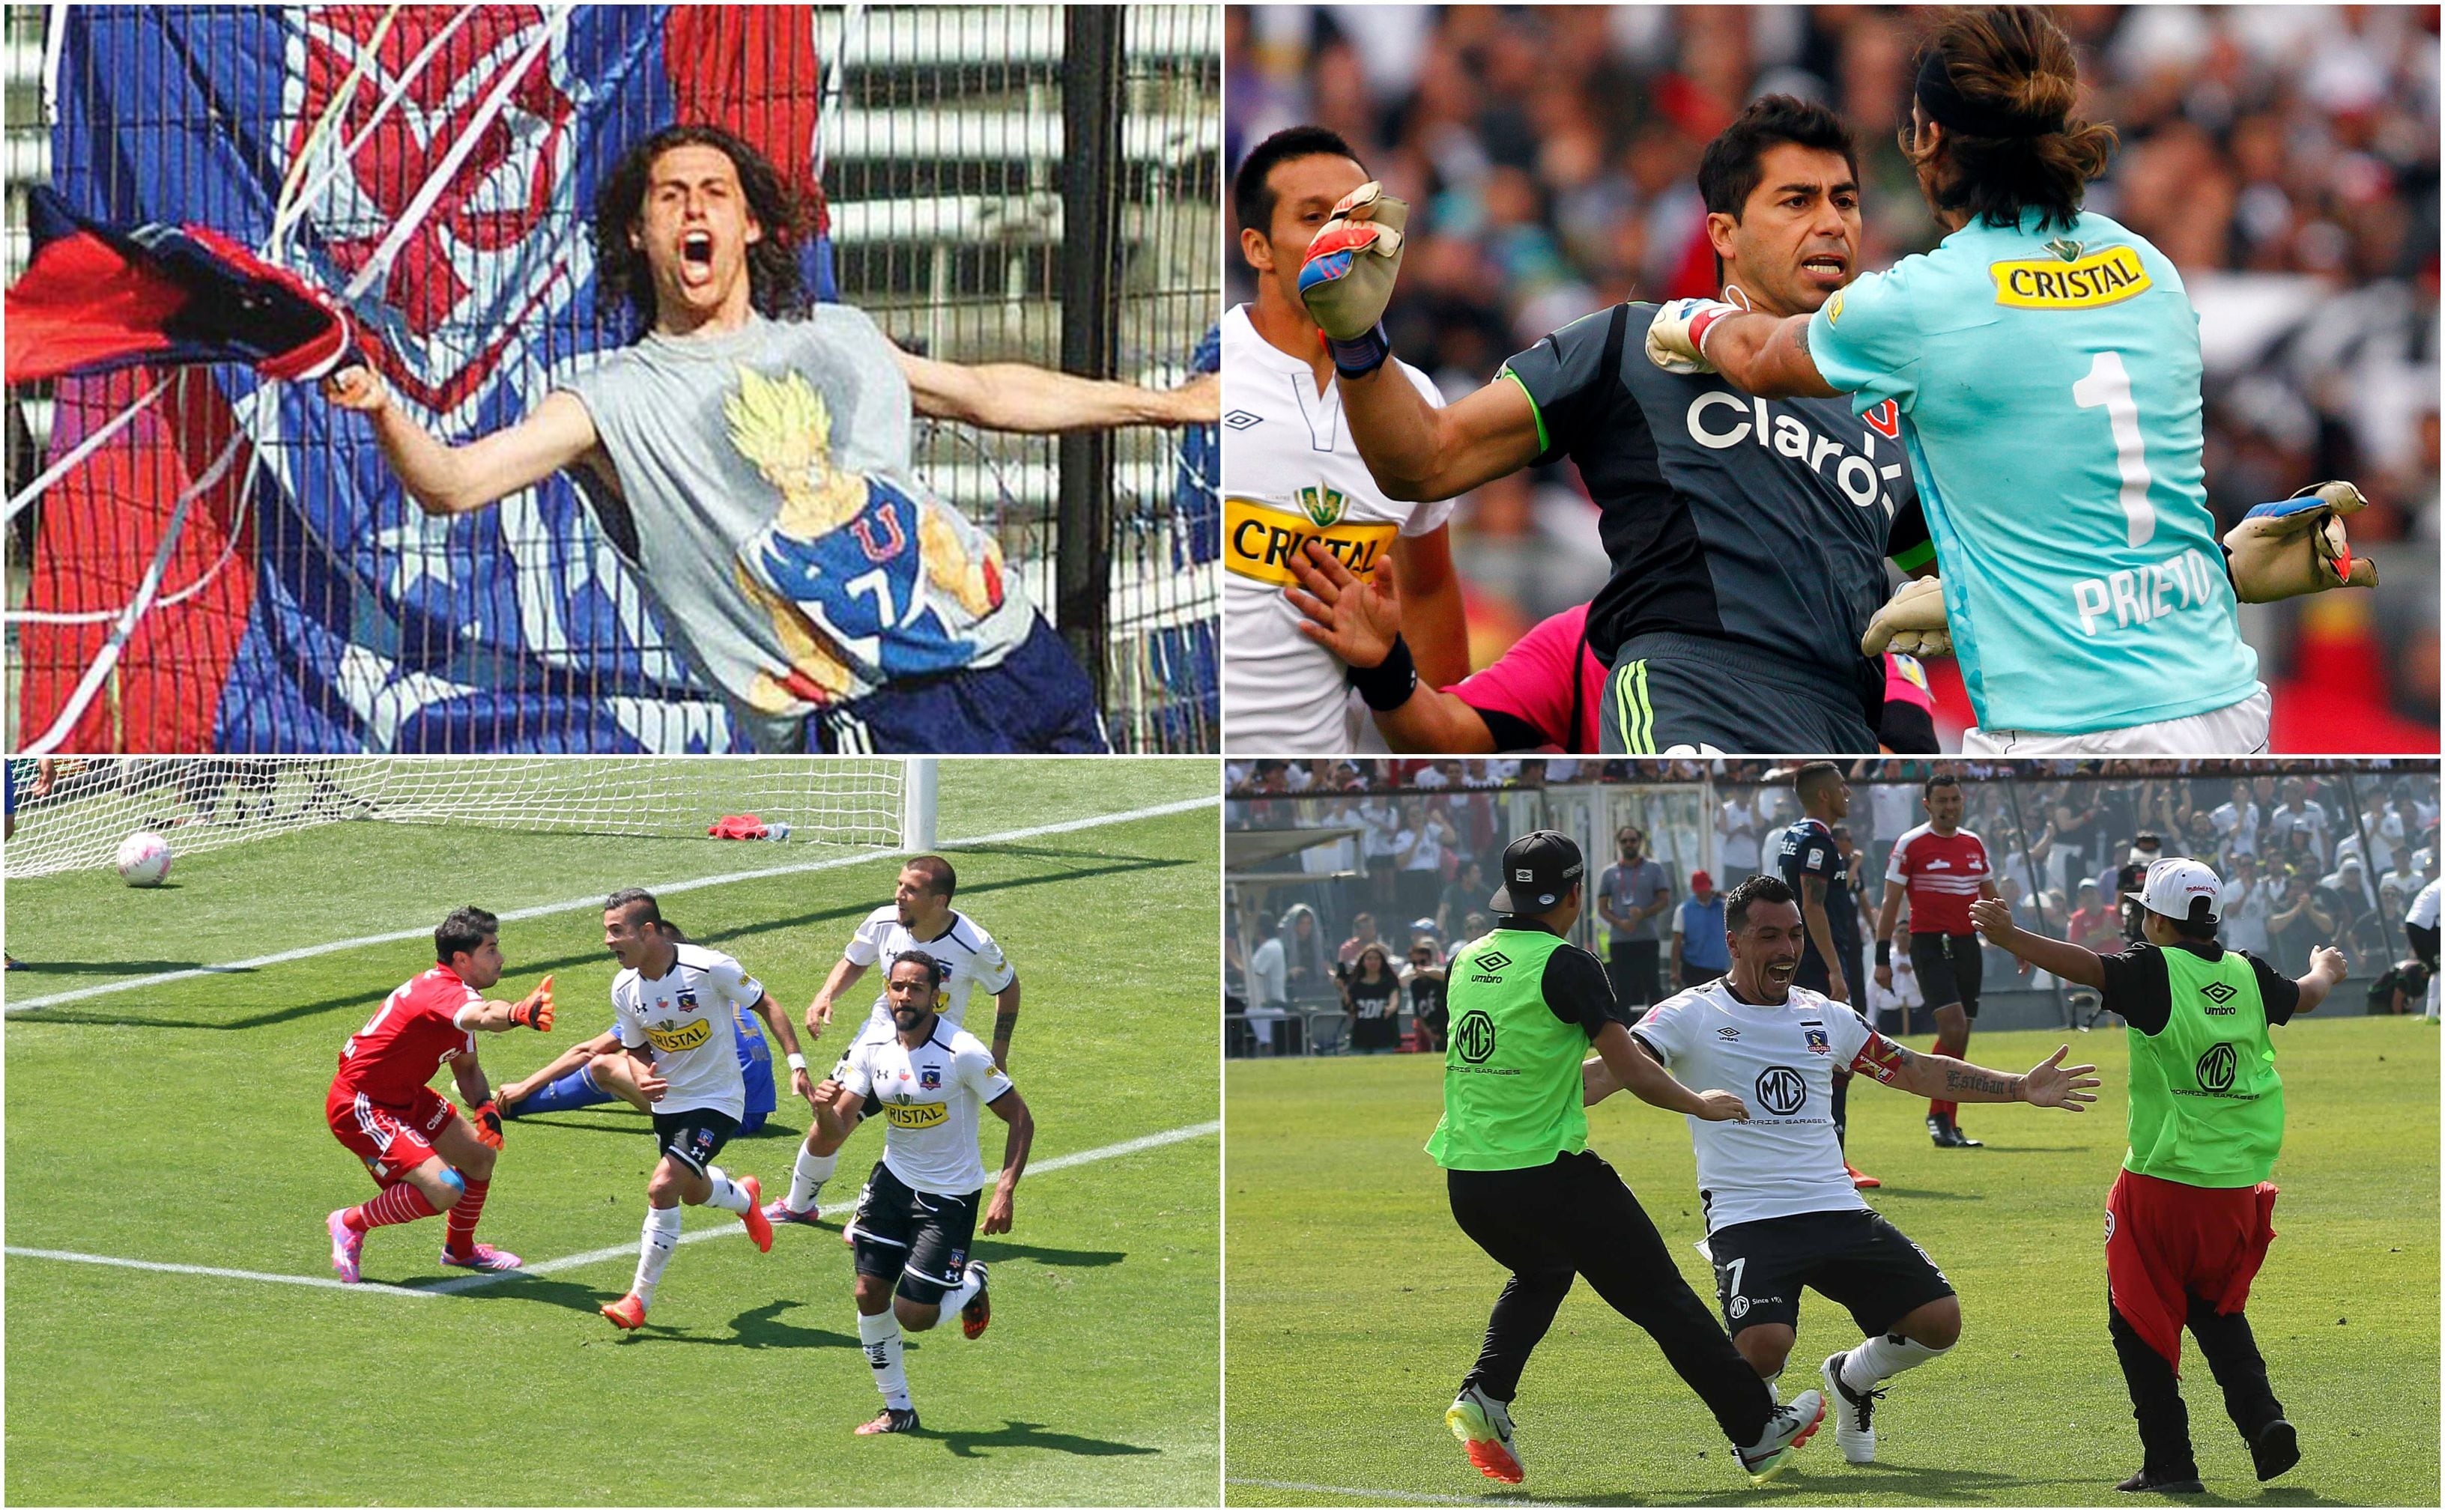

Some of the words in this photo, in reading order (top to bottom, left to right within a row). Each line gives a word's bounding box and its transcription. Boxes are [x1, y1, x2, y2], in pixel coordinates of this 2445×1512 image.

[2009, 257, 2142, 299] CRISTAL
[1686, 390, 1879, 508] Claro
[2072, 350, 2156, 549] 1
[849, 502, 906, 562] U
[844, 568, 897, 629] 7
[2072, 547, 2211, 637] PRIETO
[1471, 974, 1503, 984] umbro
[2204, 1005, 2237, 1015] umbro
[1474, 1067, 1521, 1076] GARAGES
[426, 1100, 449, 1131] Claro
[1726, 1257, 1746, 1299] 7
